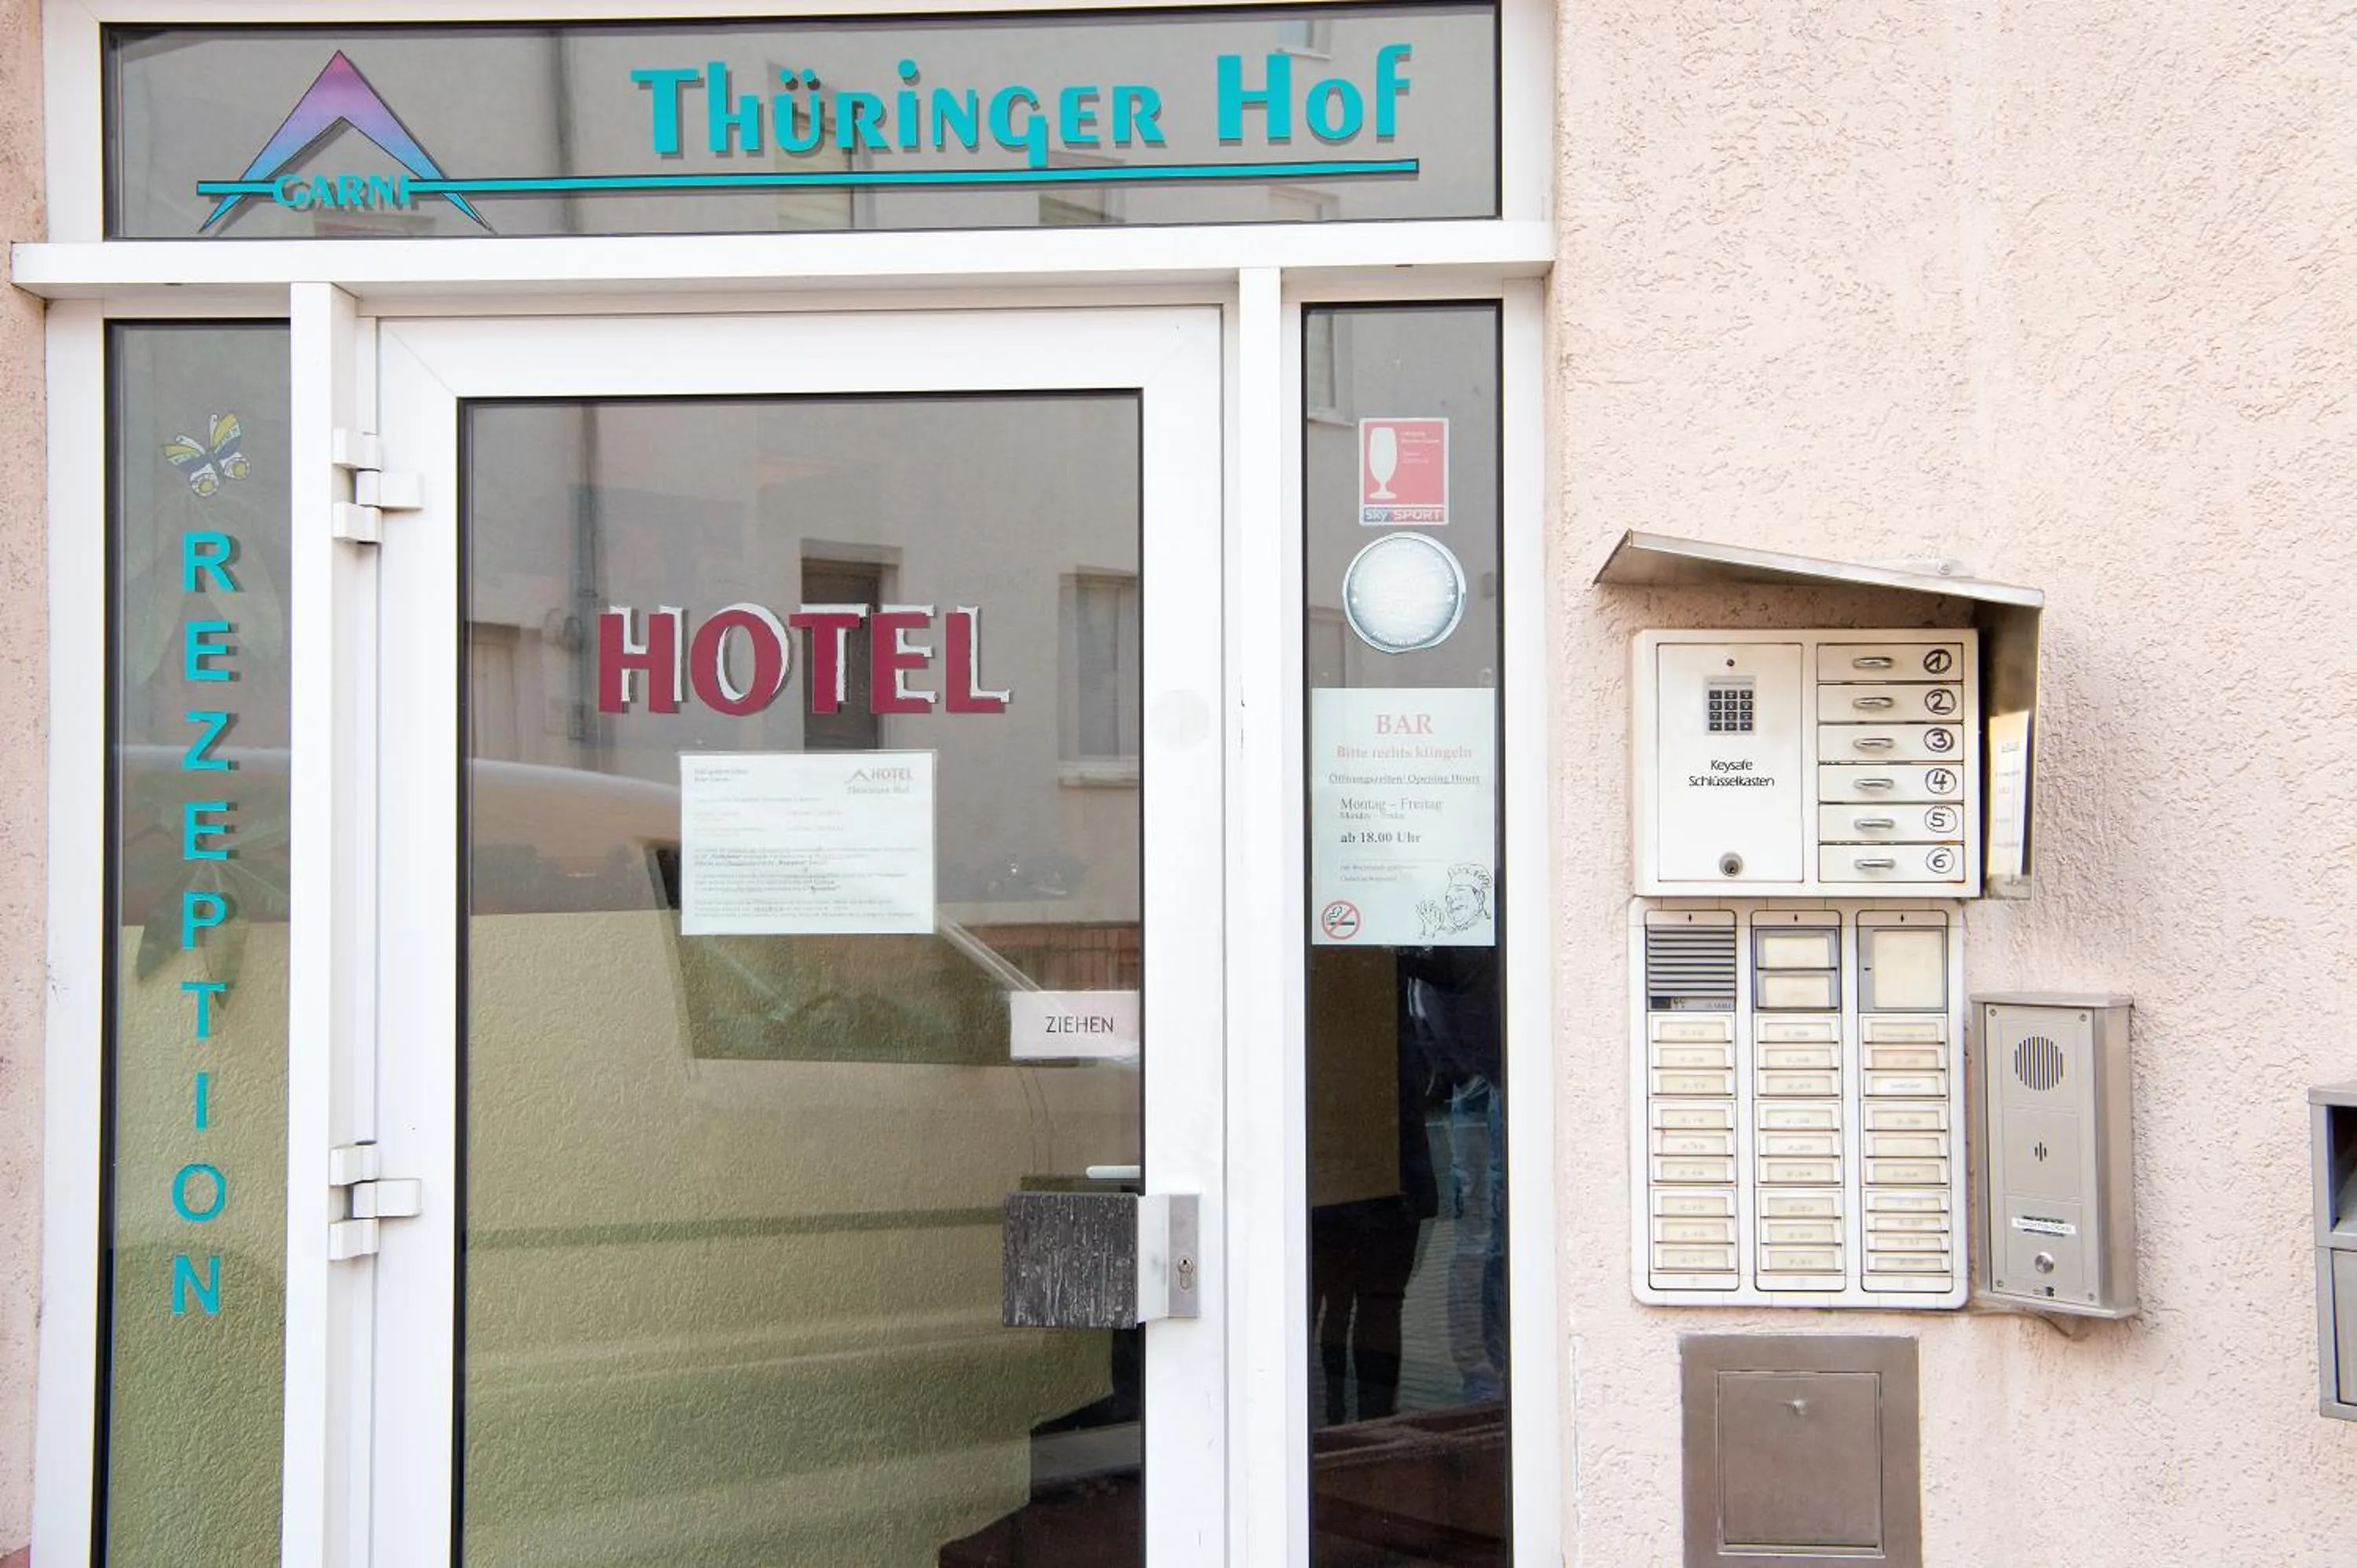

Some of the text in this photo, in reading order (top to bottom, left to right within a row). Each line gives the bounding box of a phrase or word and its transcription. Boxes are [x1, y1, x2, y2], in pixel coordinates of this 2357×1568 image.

[1217, 43, 1413, 145] Hof
[273, 174, 410, 207] GARNI
[1393, 508, 1442, 521] SPORT
[598, 603, 1012, 716] HOTEL
[1375, 713, 1434, 735] BAR
[1336, 745, 1472, 760] Bitte rechts klingeln
[871, 767, 915, 780] HOTEL
[1710, 760, 1753, 774] Keysafe
[1688, 775, 1775, 786] Schlüsselkasten
[1340, 797, 1386, 811] Montag
[1400, 797, 1444, 811] Freitag
[1340, 830, 1422, 843] ab 18.00 Uhr
[172, 530, 235, 1316] REZEPTION
[1044, 1016, 1114, 1033] ZIEHEN
